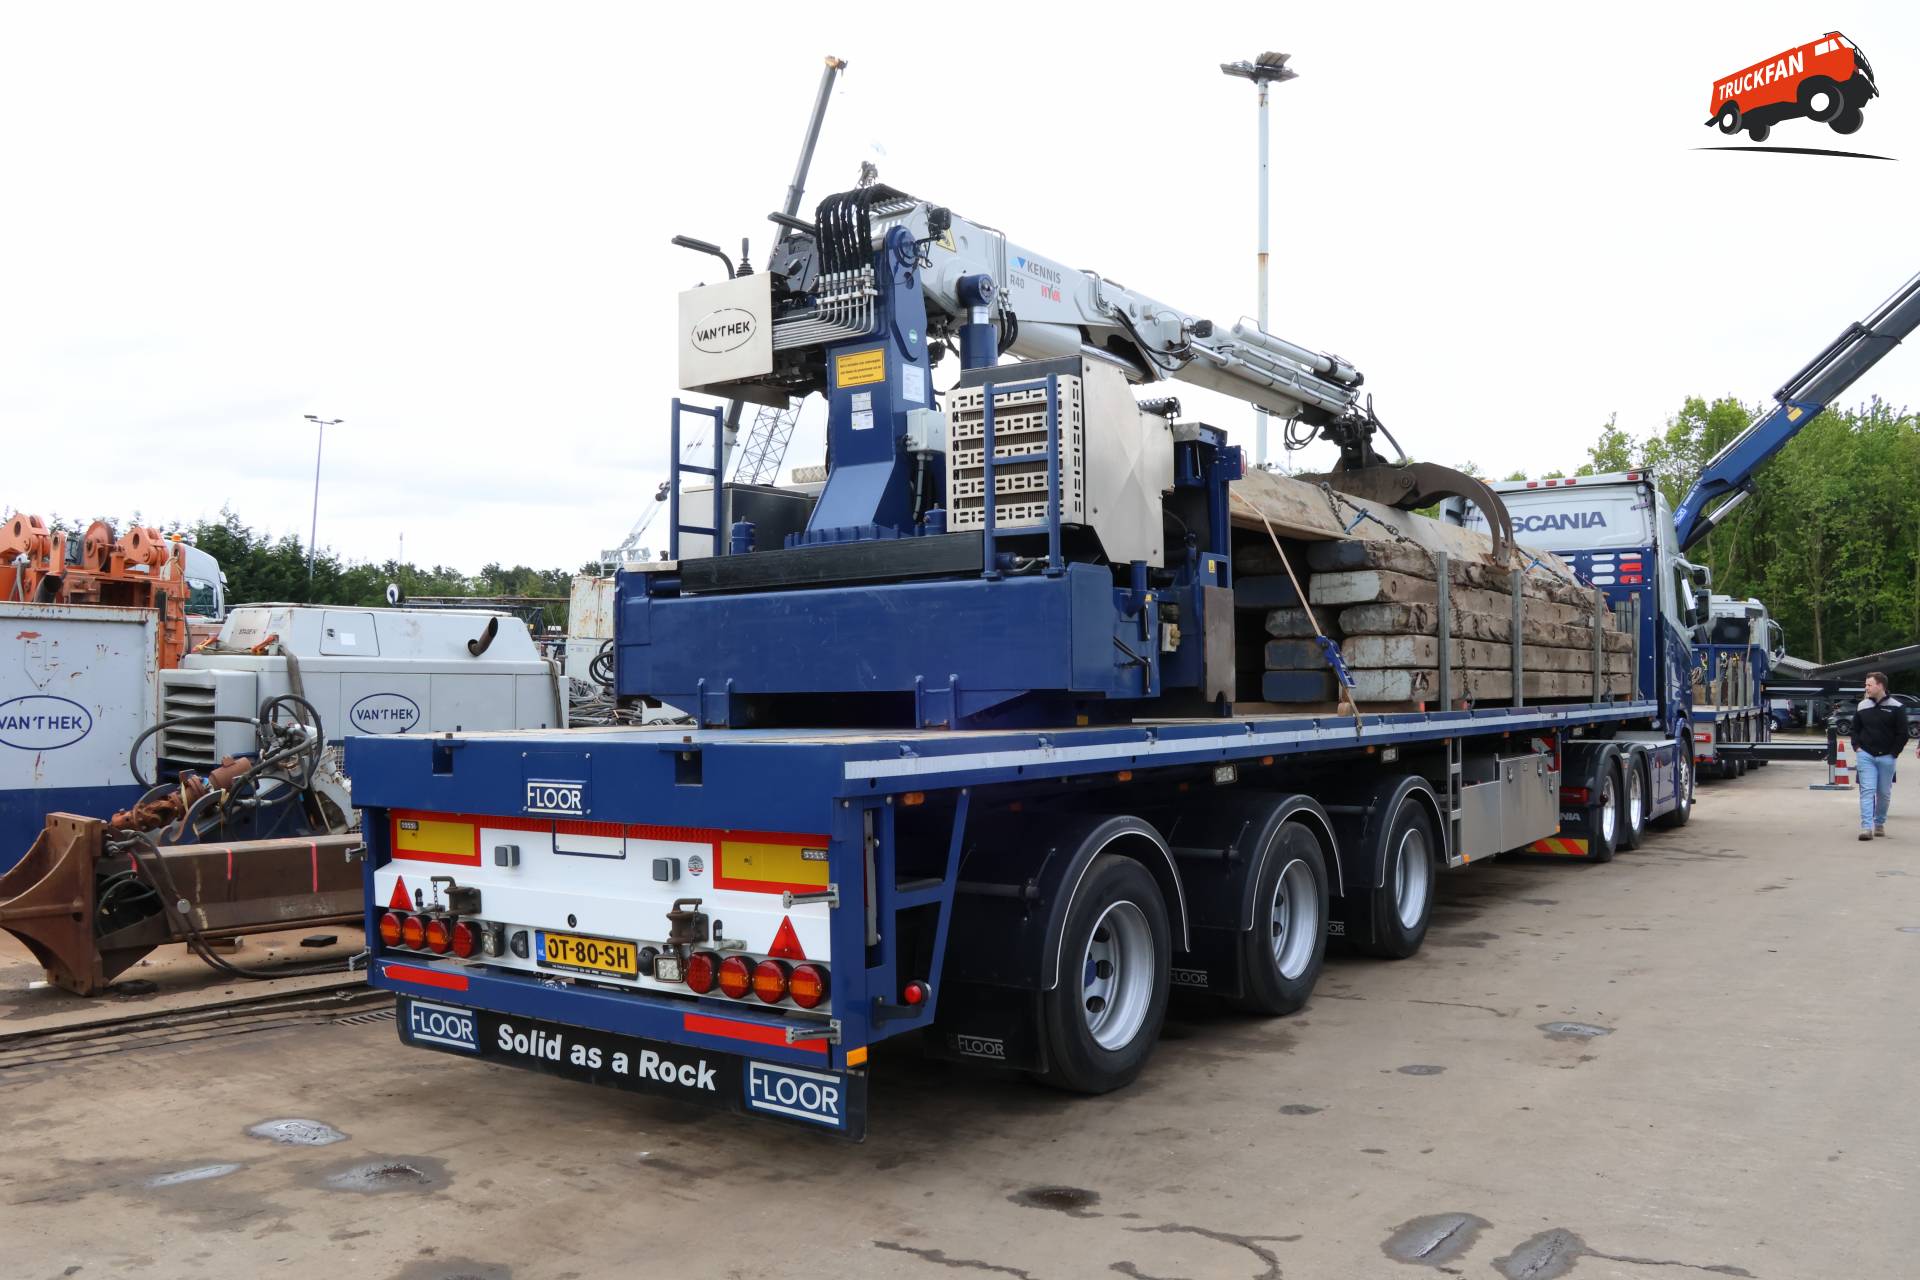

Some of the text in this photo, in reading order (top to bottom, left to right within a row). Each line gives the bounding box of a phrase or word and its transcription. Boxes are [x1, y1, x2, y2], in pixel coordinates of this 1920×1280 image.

[1010, 274, 1024, 289] R40
[1027, 260, 1061, 285] KENNIS
[727, 320, 750, 336] HEK
[1510, 511, 1607, 534] SCANIA
[48, 715, 82, 730] HEK
[390, 708, 413, 720] HEK
[527, 782, 582, 810] FLOOR
[548, 938, 628, 969] OT-80-SH
[411, 1000, 475, 1043] FLOOR
[498, 1023, 717, 1091] Solid as a Rock
[957, 1034, 1005, 1057] FLOOR
[750, 1060, 840, 1115] FLOOR
